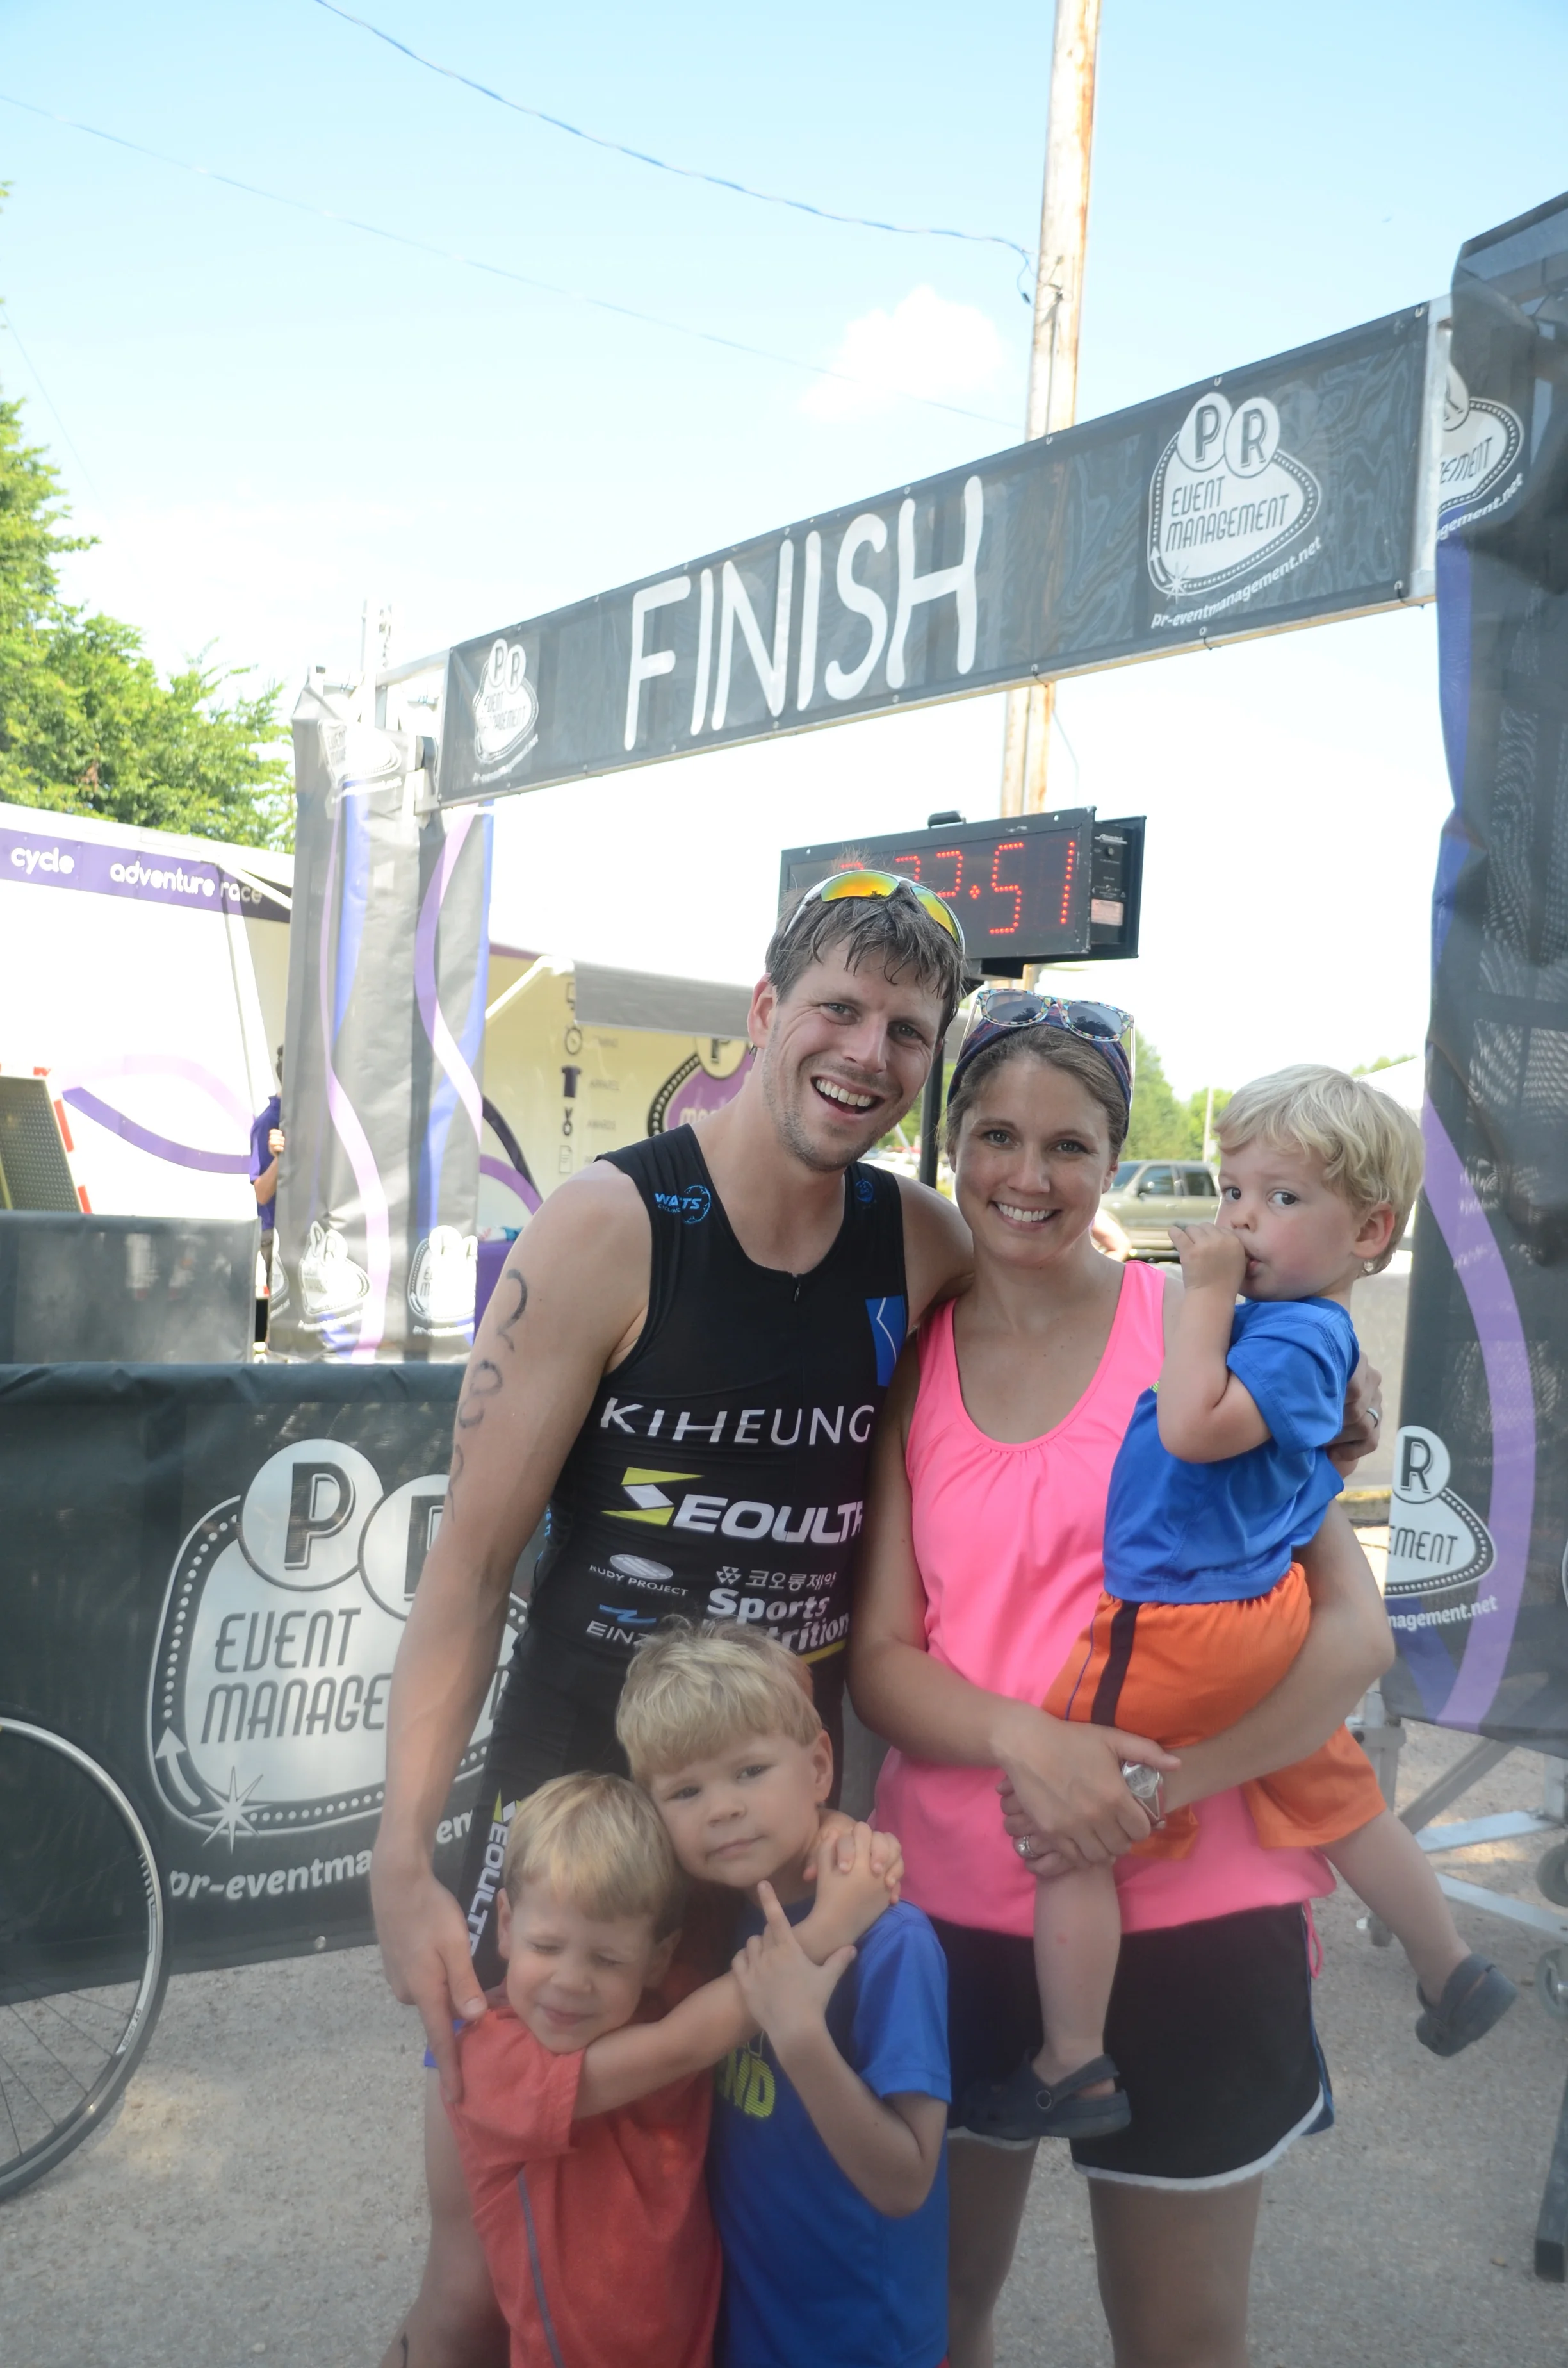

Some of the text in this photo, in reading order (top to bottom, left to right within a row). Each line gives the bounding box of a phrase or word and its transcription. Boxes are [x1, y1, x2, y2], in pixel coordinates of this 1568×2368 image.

[1195, 404, 1268, 468] P R
[1171, 476, 1225, 516] EVENT
[1165, 494, 1289, 552] MANAGEMENT
[1150, 536, 1322, 628] pr-eventmanagement.net
[624, 475, 983, 751] FINISH
[10, 847, 75, 875] cycle
[110, 861, 263, 904] adventure race
[655, 1193, 702, 1210] WATS
[600, 1397, 875, 1446] KIHEUNG
[1400, 1435, 1433, 1493] R
[284, 1461, 356, 1570] P
[589, 1565, 689, 1597] RUDY PROJECT
[745, 1569, 837, 1592] 코오롱제약
[707, 1588, 830, 1626] Sports
[215, 1607, 361, 1673] EVENT
